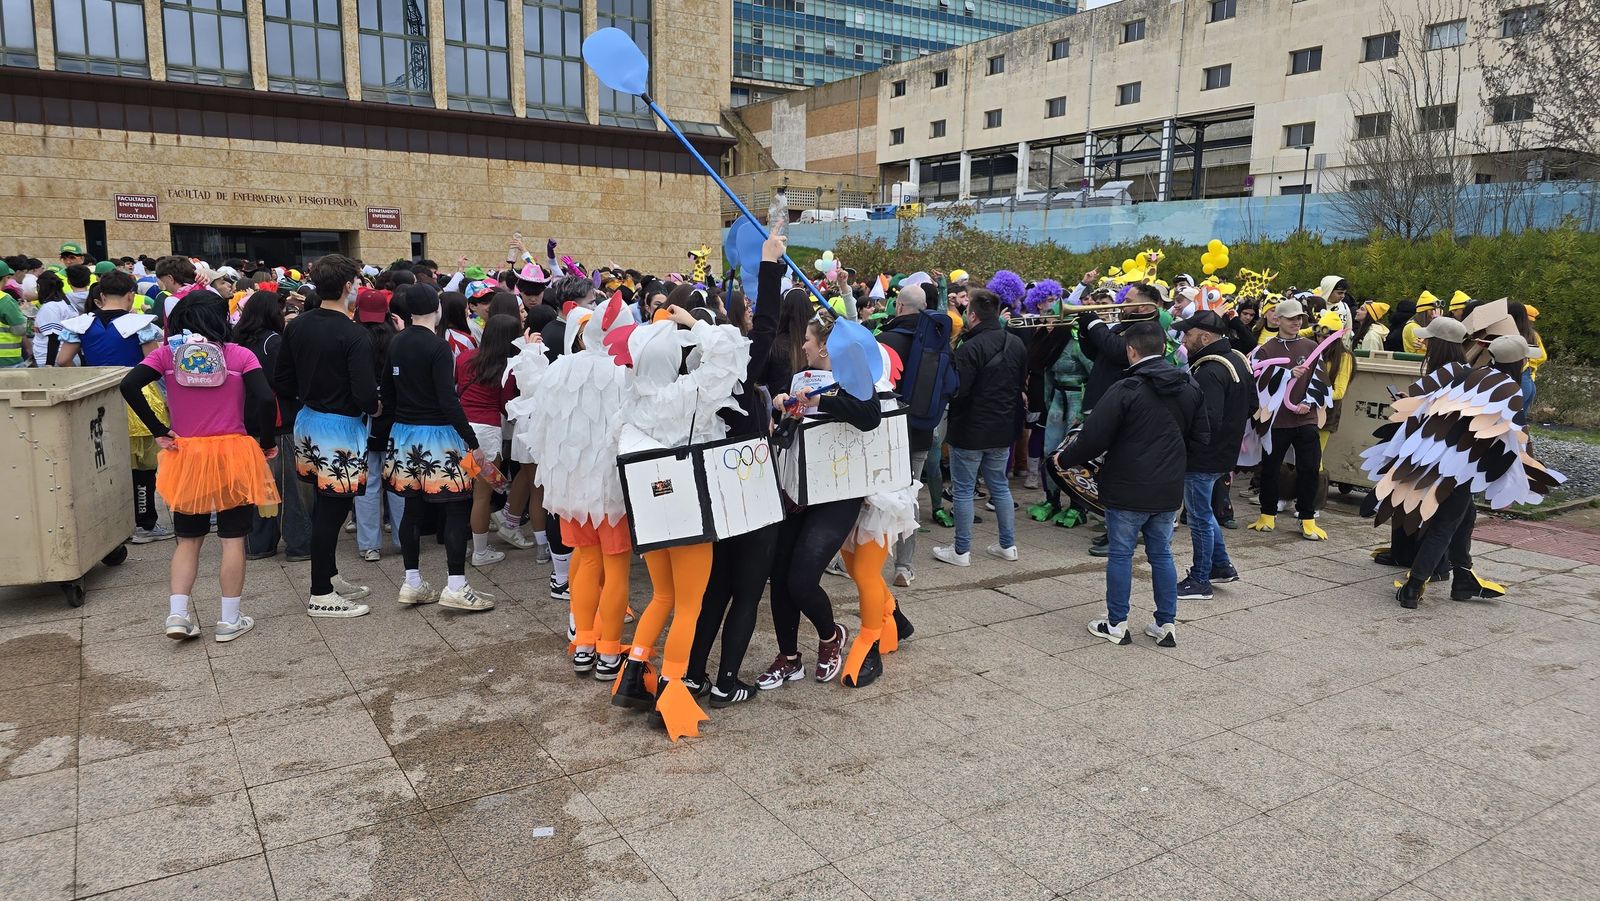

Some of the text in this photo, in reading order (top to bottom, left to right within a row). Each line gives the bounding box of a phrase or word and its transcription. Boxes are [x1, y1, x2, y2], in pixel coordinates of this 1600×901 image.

[168, 188, 210, 200] FACULTAD
[216, 191, 228, 201] DE
[287, 195, 293, 203] Y
[299, 195, 358, 208] FISIOTERAPIA
